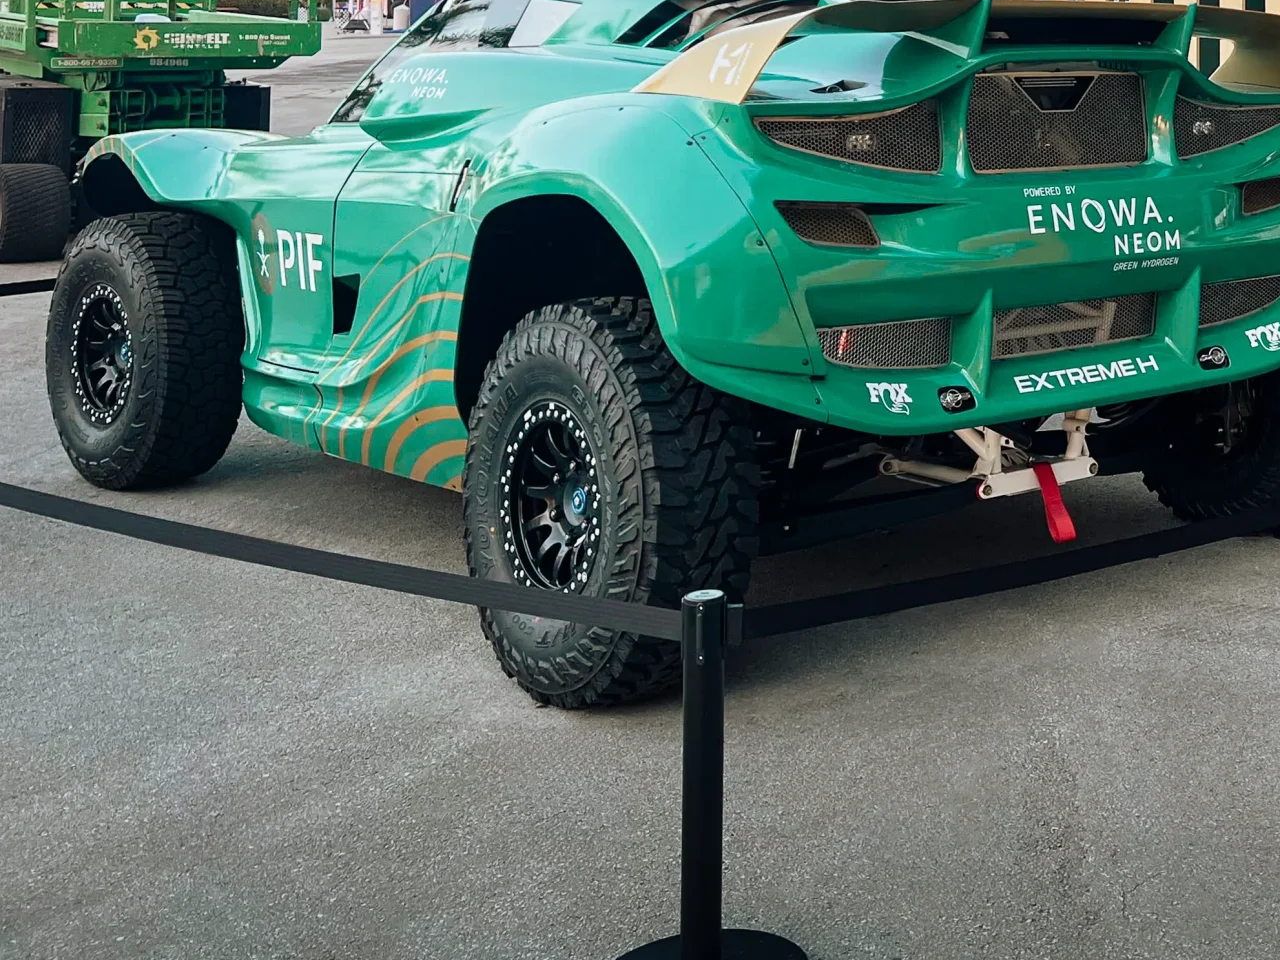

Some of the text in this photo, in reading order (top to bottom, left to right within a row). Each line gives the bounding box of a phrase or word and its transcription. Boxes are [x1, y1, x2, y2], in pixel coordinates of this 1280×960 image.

[411, 86, 447, 99] NEOM
[1023, 185, 1076, 198] POWERED BY
[1114, 229, 1181, 256] NEOM
[276, 229, 323, 292] PIF
[1113, 257, 1179, 272] GREEN HYDROGEN
[865, 382, 913, 416] FOX
